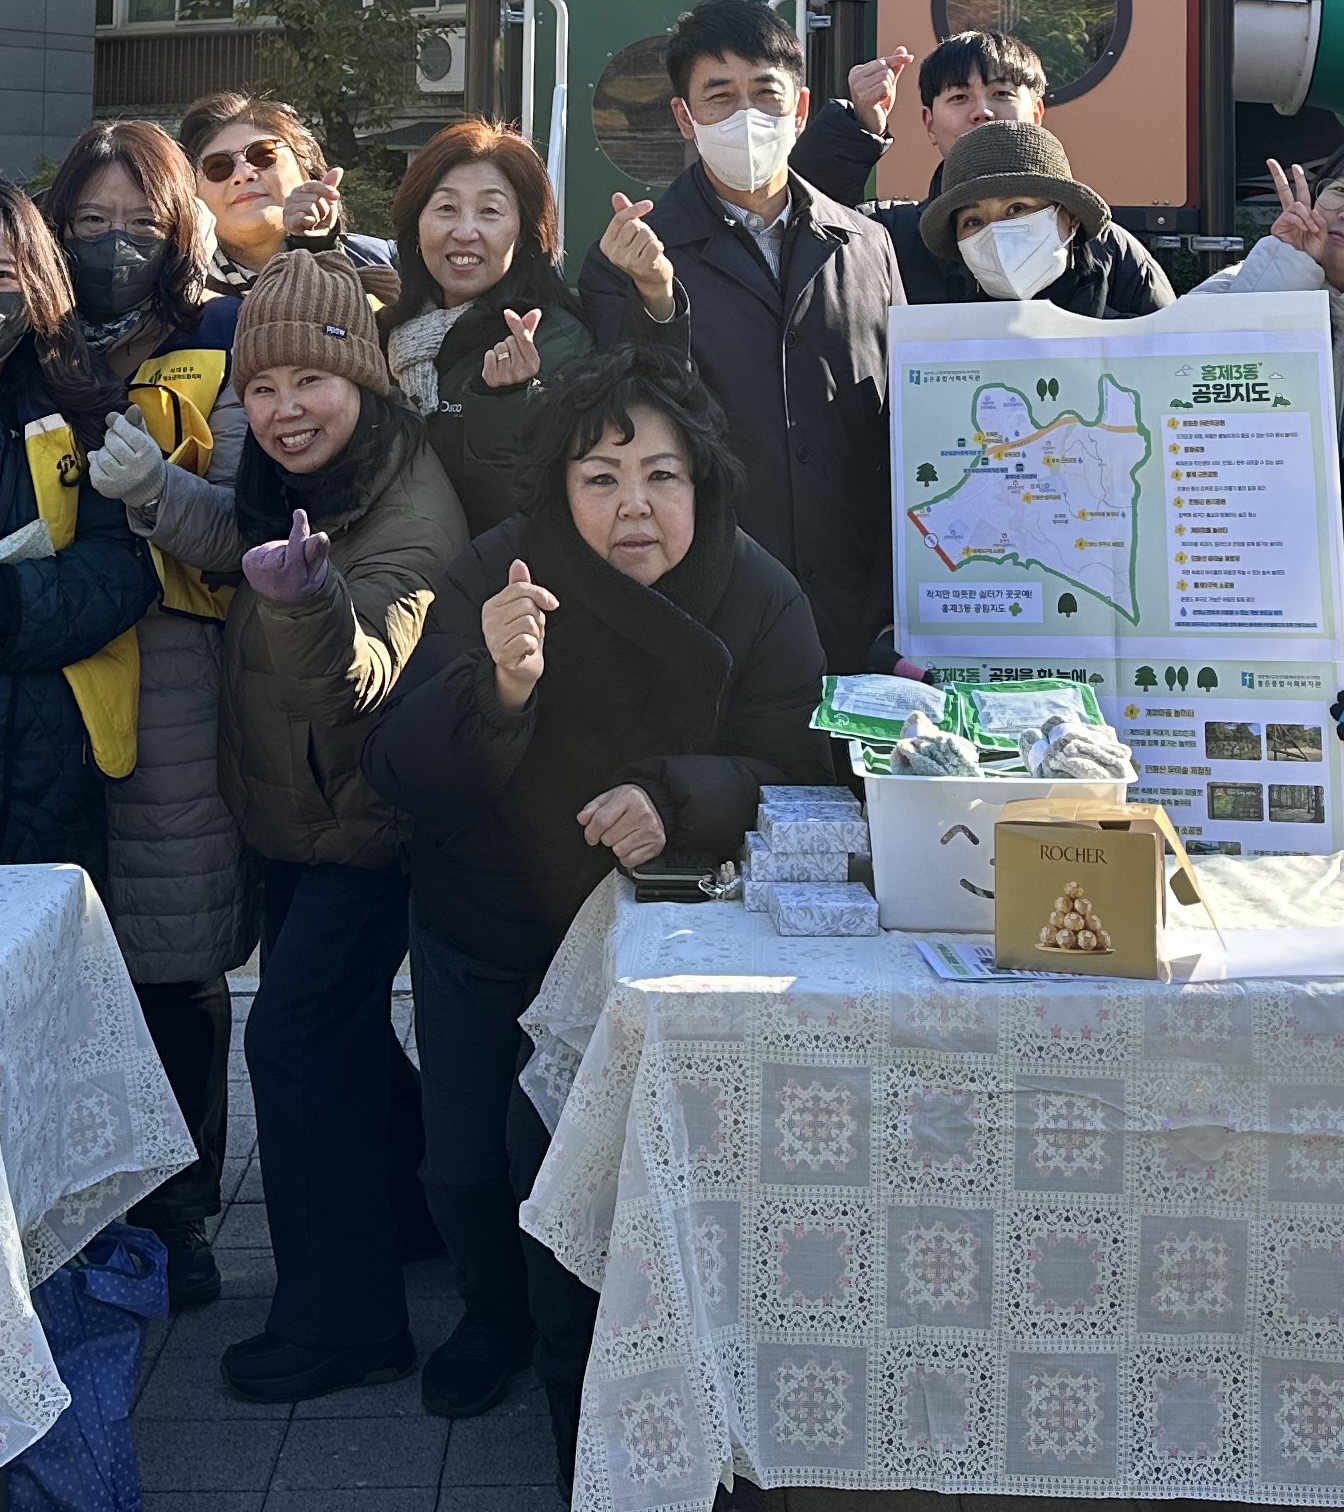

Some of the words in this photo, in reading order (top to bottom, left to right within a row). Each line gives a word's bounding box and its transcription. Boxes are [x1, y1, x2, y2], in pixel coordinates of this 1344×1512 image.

[1200, 363, 1259, 381] 홍제3동
[1192, 382, 1271, 404] 공원지도
[926, 590, 950, 600] 작지만
[952, 590, 976, 600] 따뜻한
[942, 604, 971, 614] 홍제3동
[974, 604, 1006, 614] 공원지도
[989, 667, 1034, 682] 공원을
[1040, 844, 1108, 866] ROCHER
